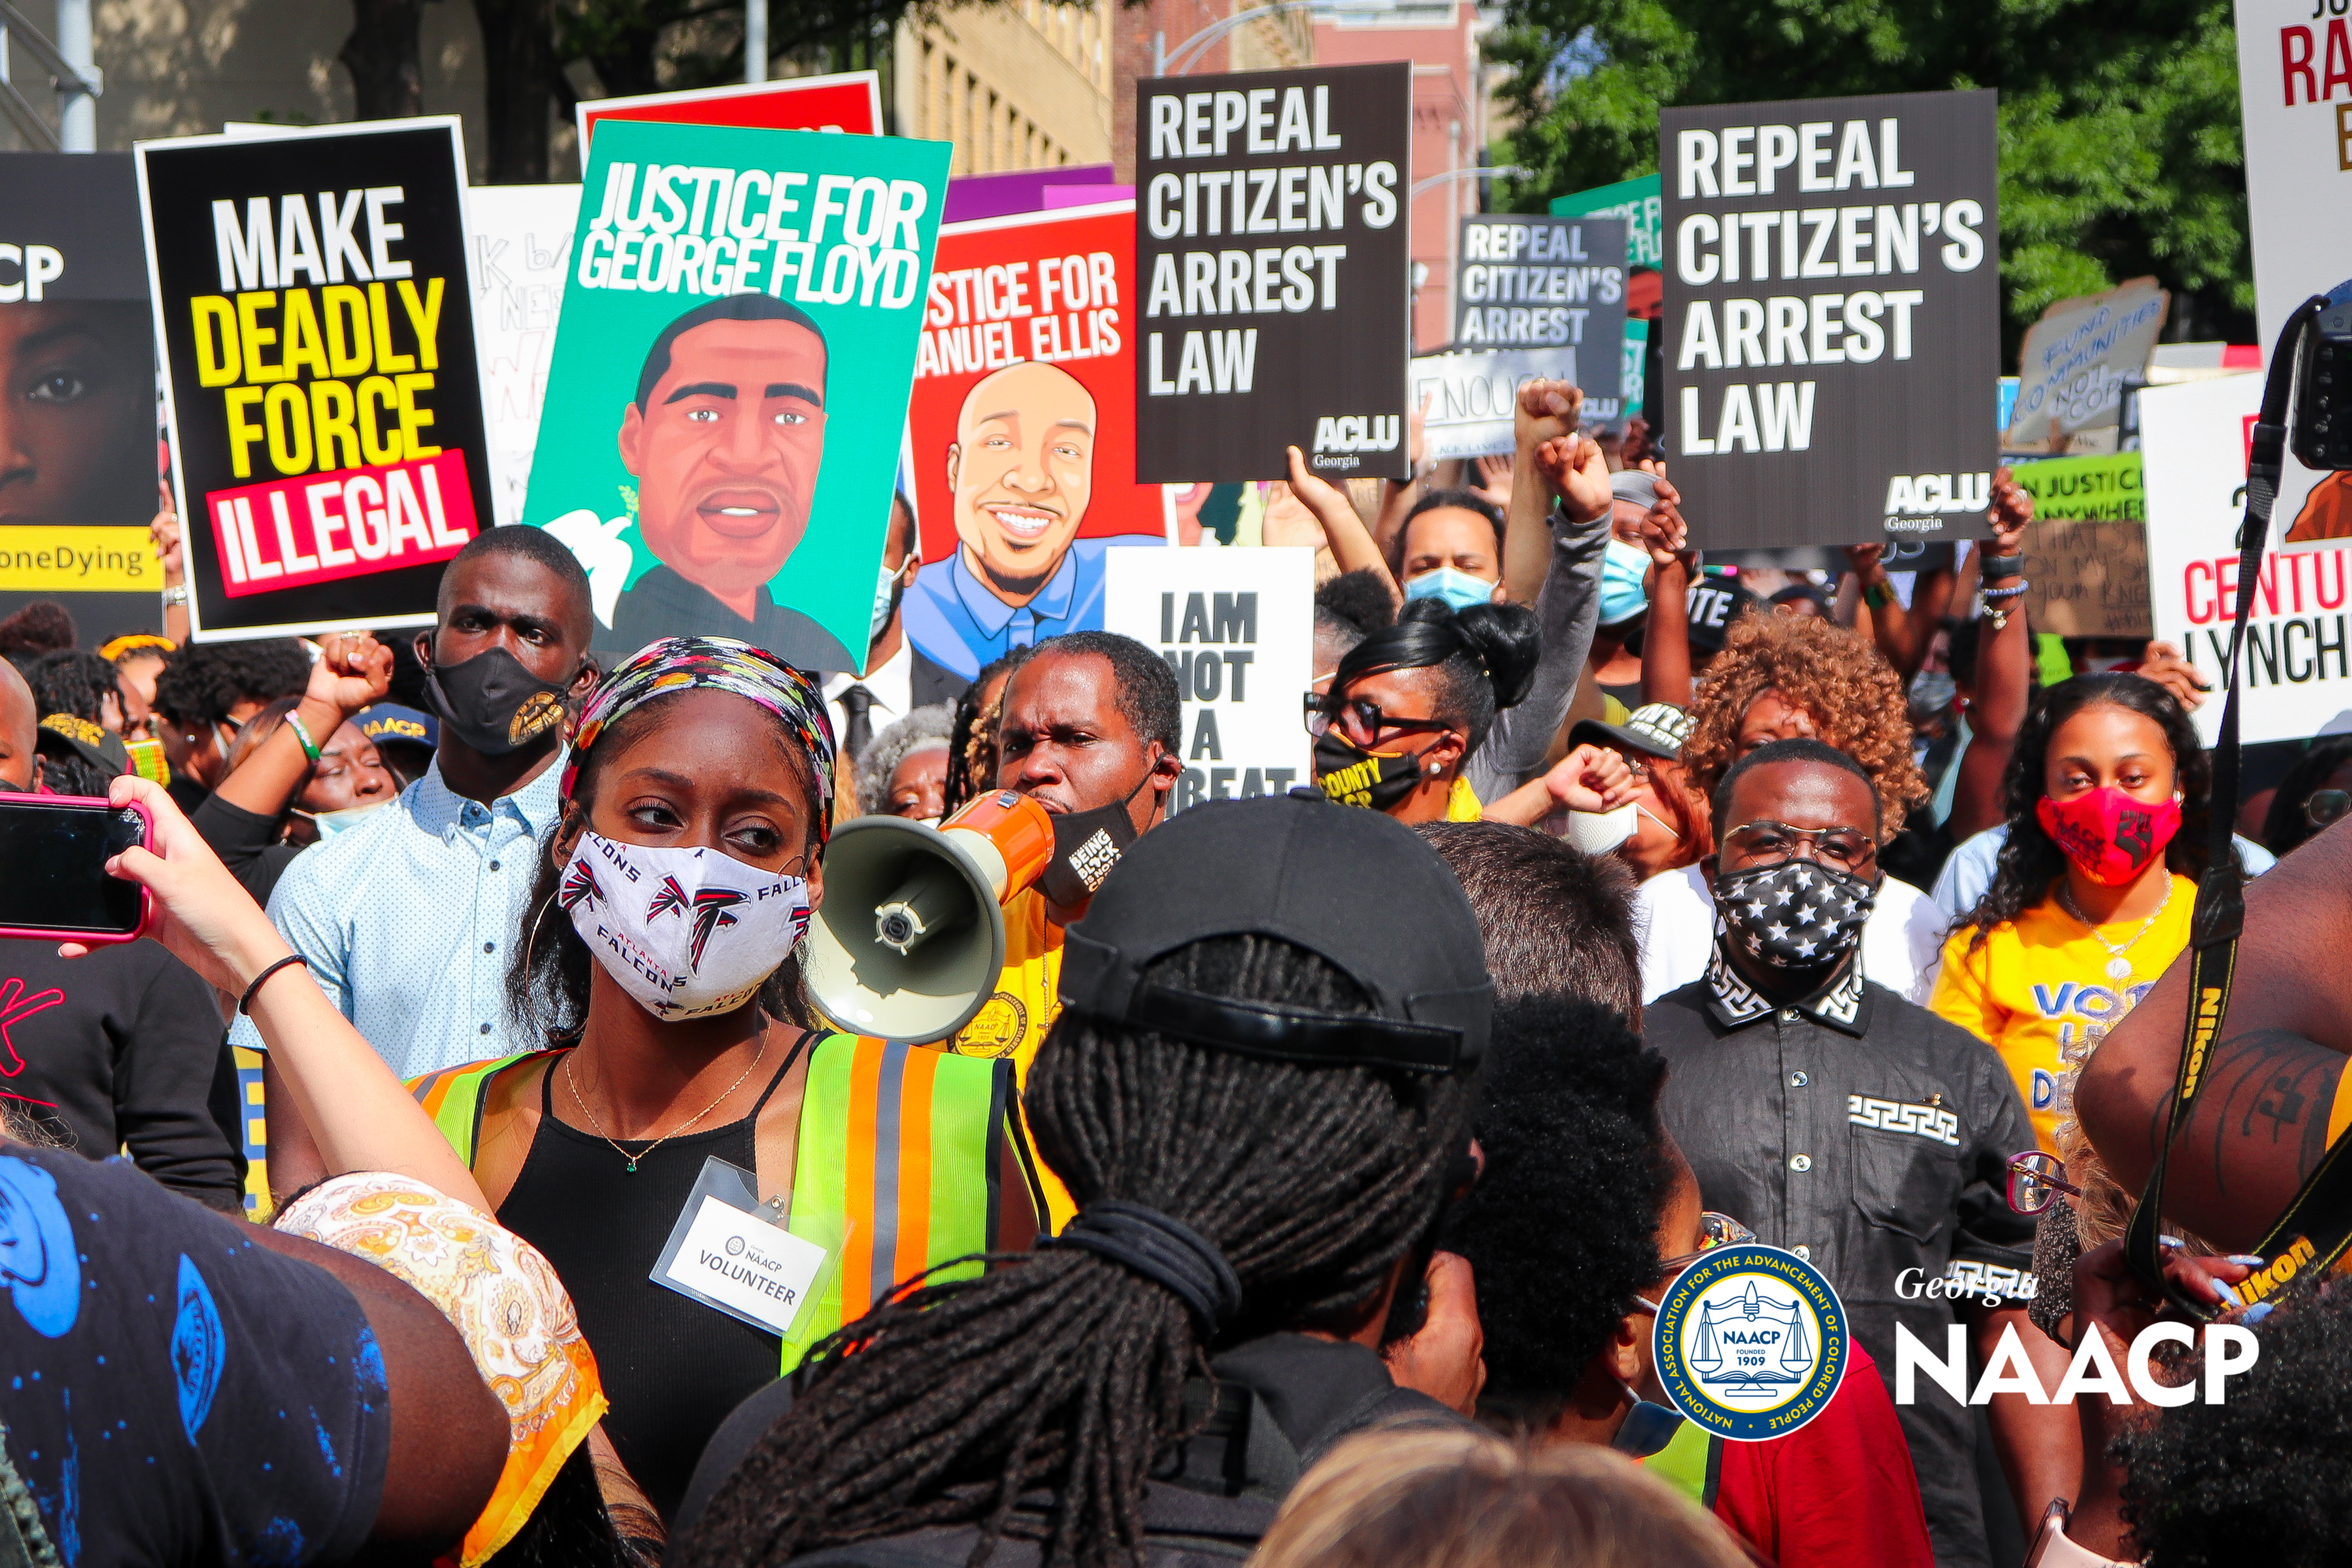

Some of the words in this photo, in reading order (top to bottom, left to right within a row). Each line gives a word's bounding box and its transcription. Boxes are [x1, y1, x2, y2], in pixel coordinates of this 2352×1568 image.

[1149, 84, 1341, 159] REPEAL
[1678, 117, 1915, 199] REPEAL
[590, 161, 808, 242] JUSTICE
[808, 174, 927, 250] FOR
[1148, 161, 1398, 240] CITIZEN'S
[211, 185, 413, 292] MAKE
[578, 228, 768, 295] GEORGE
[771, 240, 921, 309] FLOYD
[1464, 224, 1589, 262] REPEAL
[1677, 199, 1983, 285] CITIZEN'S
[923, 261, 1033, 328] STICE
[1039, 251, 1119, 313] FOR
[1146, 245, 1346, 317] ARREST
[1463, 264, 1623, 304] CITIZEN'S
[190, 277, 445, 388] DEADLY
[914, 321, 1026, 379] ANUEL
[1031, 308, 1122, 363] ELLIS
[1459, 307, 1591, 345] ARREST
[1678, 290, 1923, 370] ARREST
[1148, 329, 1257, 395] LAW
[224, 372, 442, 478] FORCE
[1314, 415, 1399, 453] ACLU
[1580, 397, 1620, 419] CLU
[1680, 381, 1816, 455] LAW
[1313, 454, 1361, 469] Georgia
[1885, 472, 1991, 514] ACLU
[1886, 515, 1944, 532] Georgia
[216, 464, 470, 584] ILLEGAL
[1161, 591, 1175, 644] I
[1179, 591, 1258, 644] AM
[1163, 650, 1255, 703] NOT
[1189, 708, 1223, 761] A
[1164, 766, 1297, 821] REAT
[1318, 757, 1382, 798] COUNTY
[586, 831, 642, 883] CONS
[1069, 830, 1112, 871] BEING
[597, 924, 688, 994] FALCONS
[617, 932, 668, 978] ATLANTA
[2182, 987, 2222, 1099] Nikon
[700, 1249, 796, 1306] VOLUNTEER
[745, 1250, 782, 1273] NAACP
